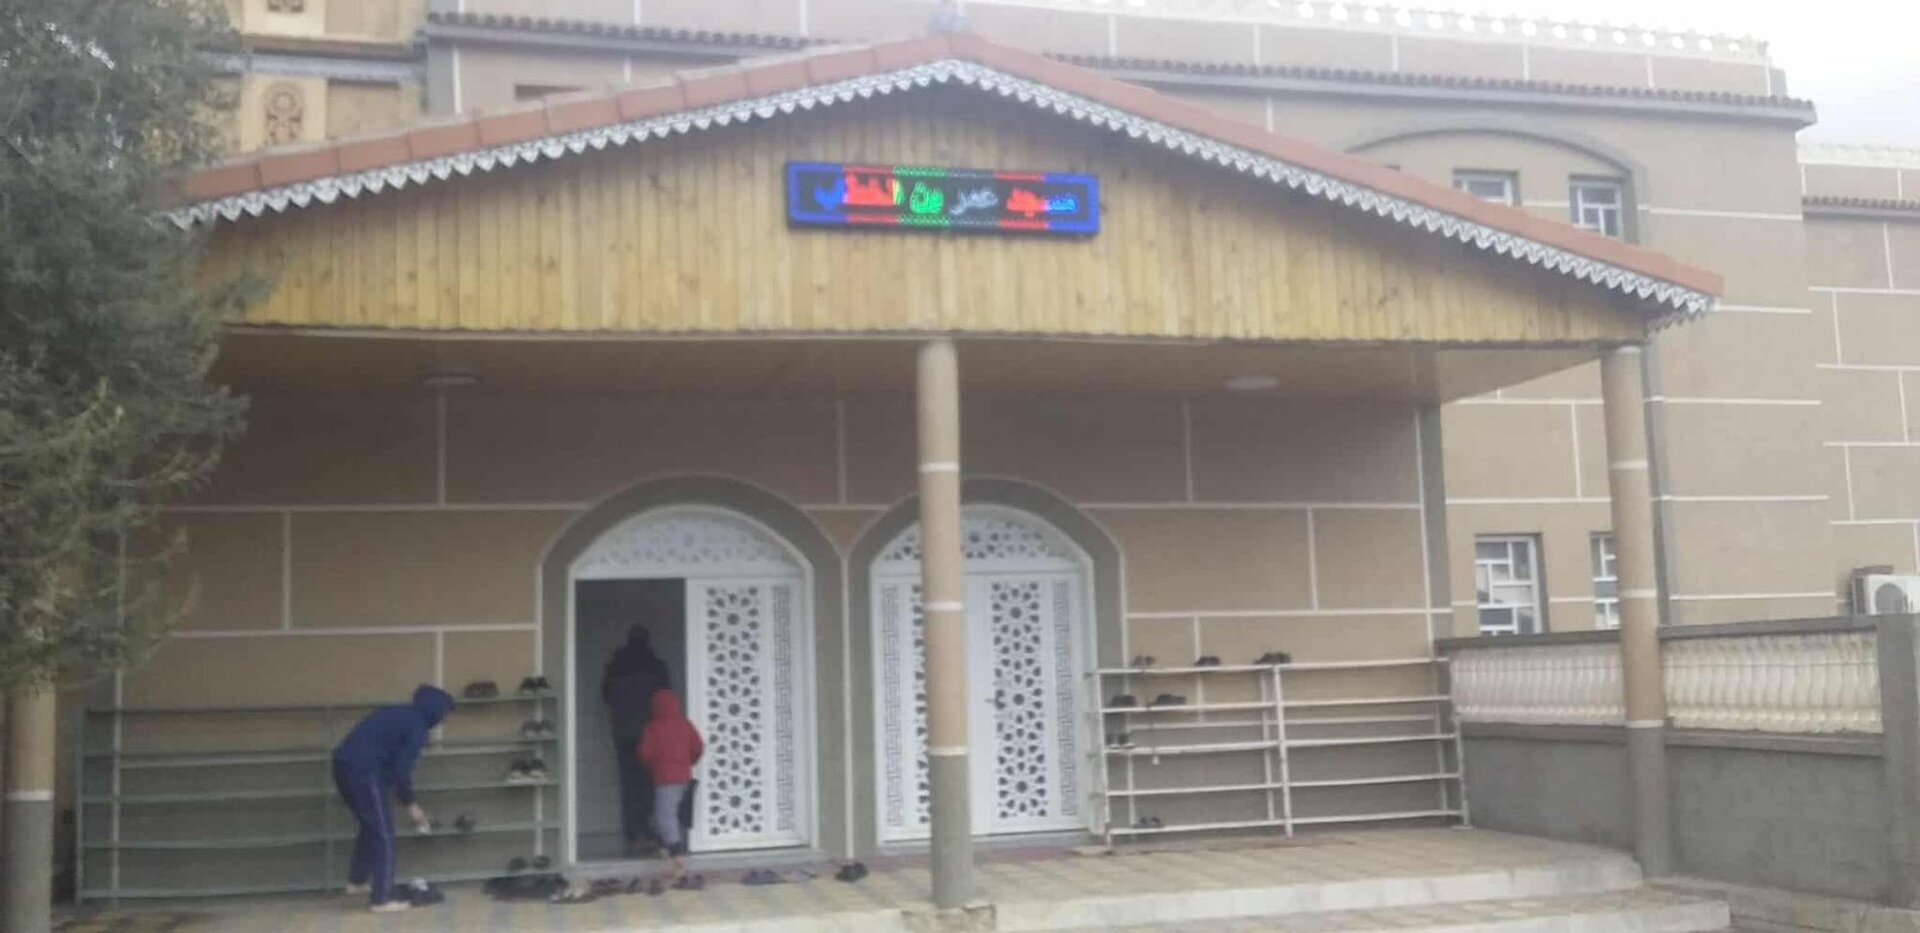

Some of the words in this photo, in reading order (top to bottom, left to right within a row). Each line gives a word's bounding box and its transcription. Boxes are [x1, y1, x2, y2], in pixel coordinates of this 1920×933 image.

[909, 182, 944, 214] بن
[950, 187, 998, 215] عمر
[1007, 188, 1077, 217] مسجد
